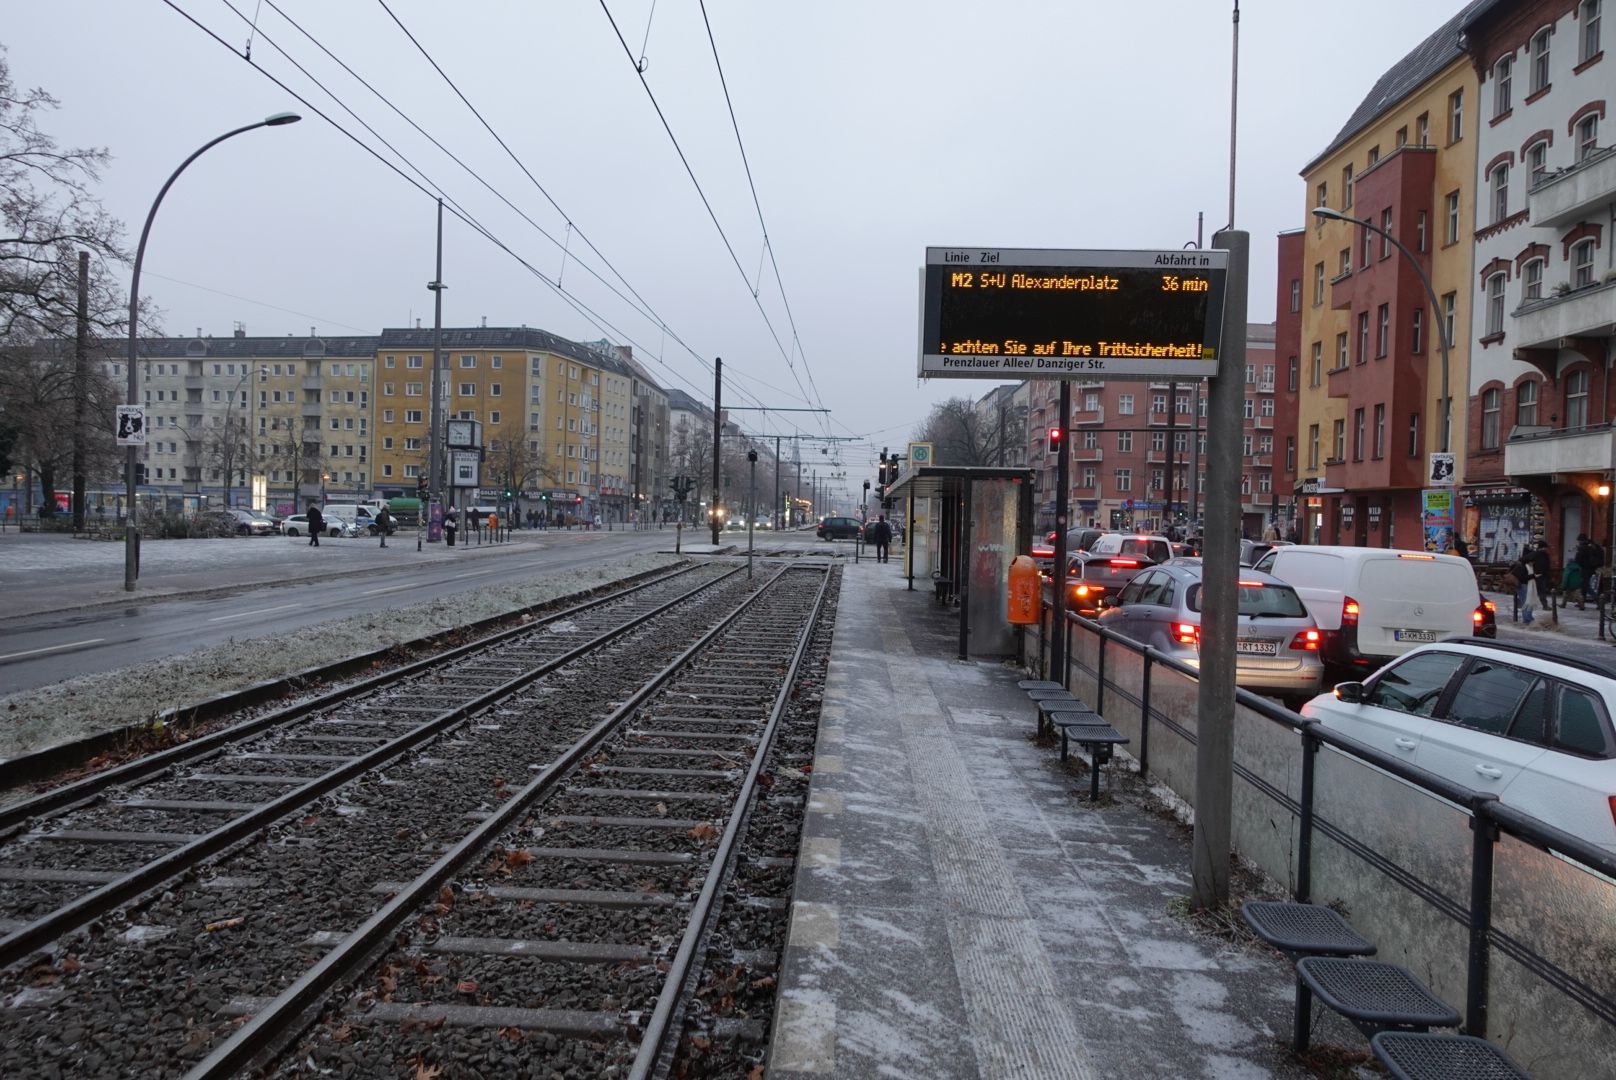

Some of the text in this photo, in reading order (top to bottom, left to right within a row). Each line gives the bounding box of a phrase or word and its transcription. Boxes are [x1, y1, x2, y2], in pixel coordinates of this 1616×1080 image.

[945, 252, 1000, 263] Linie Ziel
[1155, 254, 1210, 266] Abfahrt in
[951, 273, 1208, 292] M2 S+U Alexanderplatz 36 min
[951, 340, 999, 354] achten
[1004, 340, 1027, 355] Sie
[1032, 341, 1057, 355] auf
[1062, 341, 1092, 356] Ihre
[1098, 341, 1202, 357] Trittsicherheit!
[943, 357, 1106, 372] Prenzlauer Allee/ Danziger Str.
[1242, 643, 1275, 653] RT 1332
